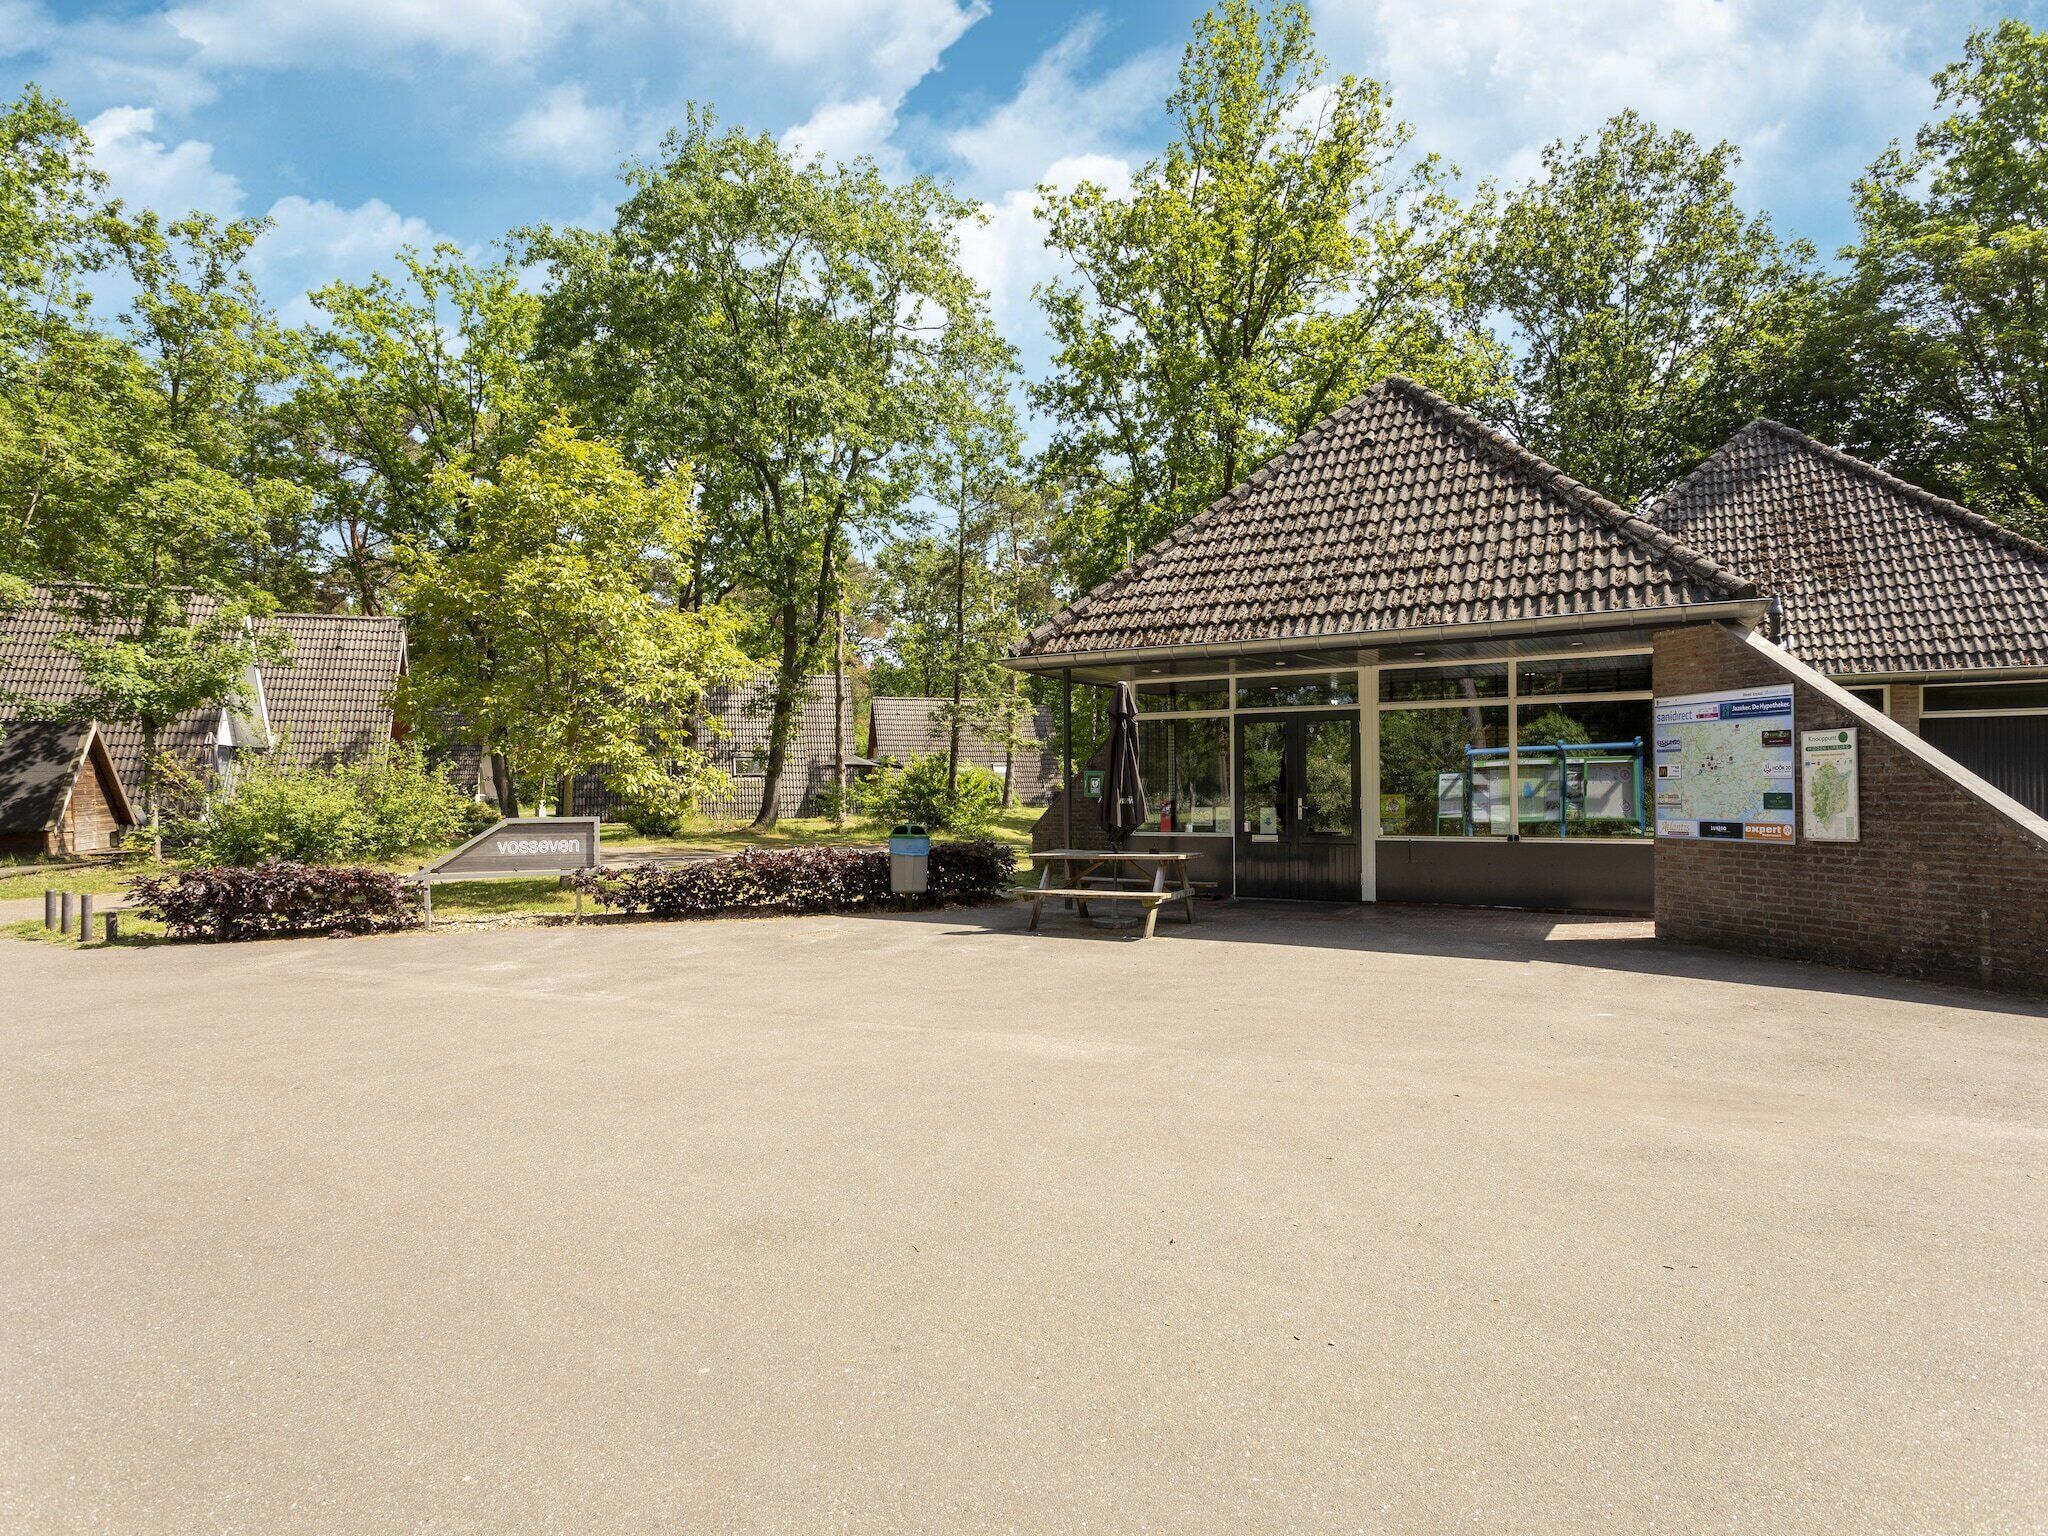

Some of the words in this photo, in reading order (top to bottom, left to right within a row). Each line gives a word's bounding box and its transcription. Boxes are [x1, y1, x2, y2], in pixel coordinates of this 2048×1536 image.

[1656, 711, 1693, 722] sanidirect
[1745, 825, 1781, 834] expert
[497, 839, 580, 855] vosseven
